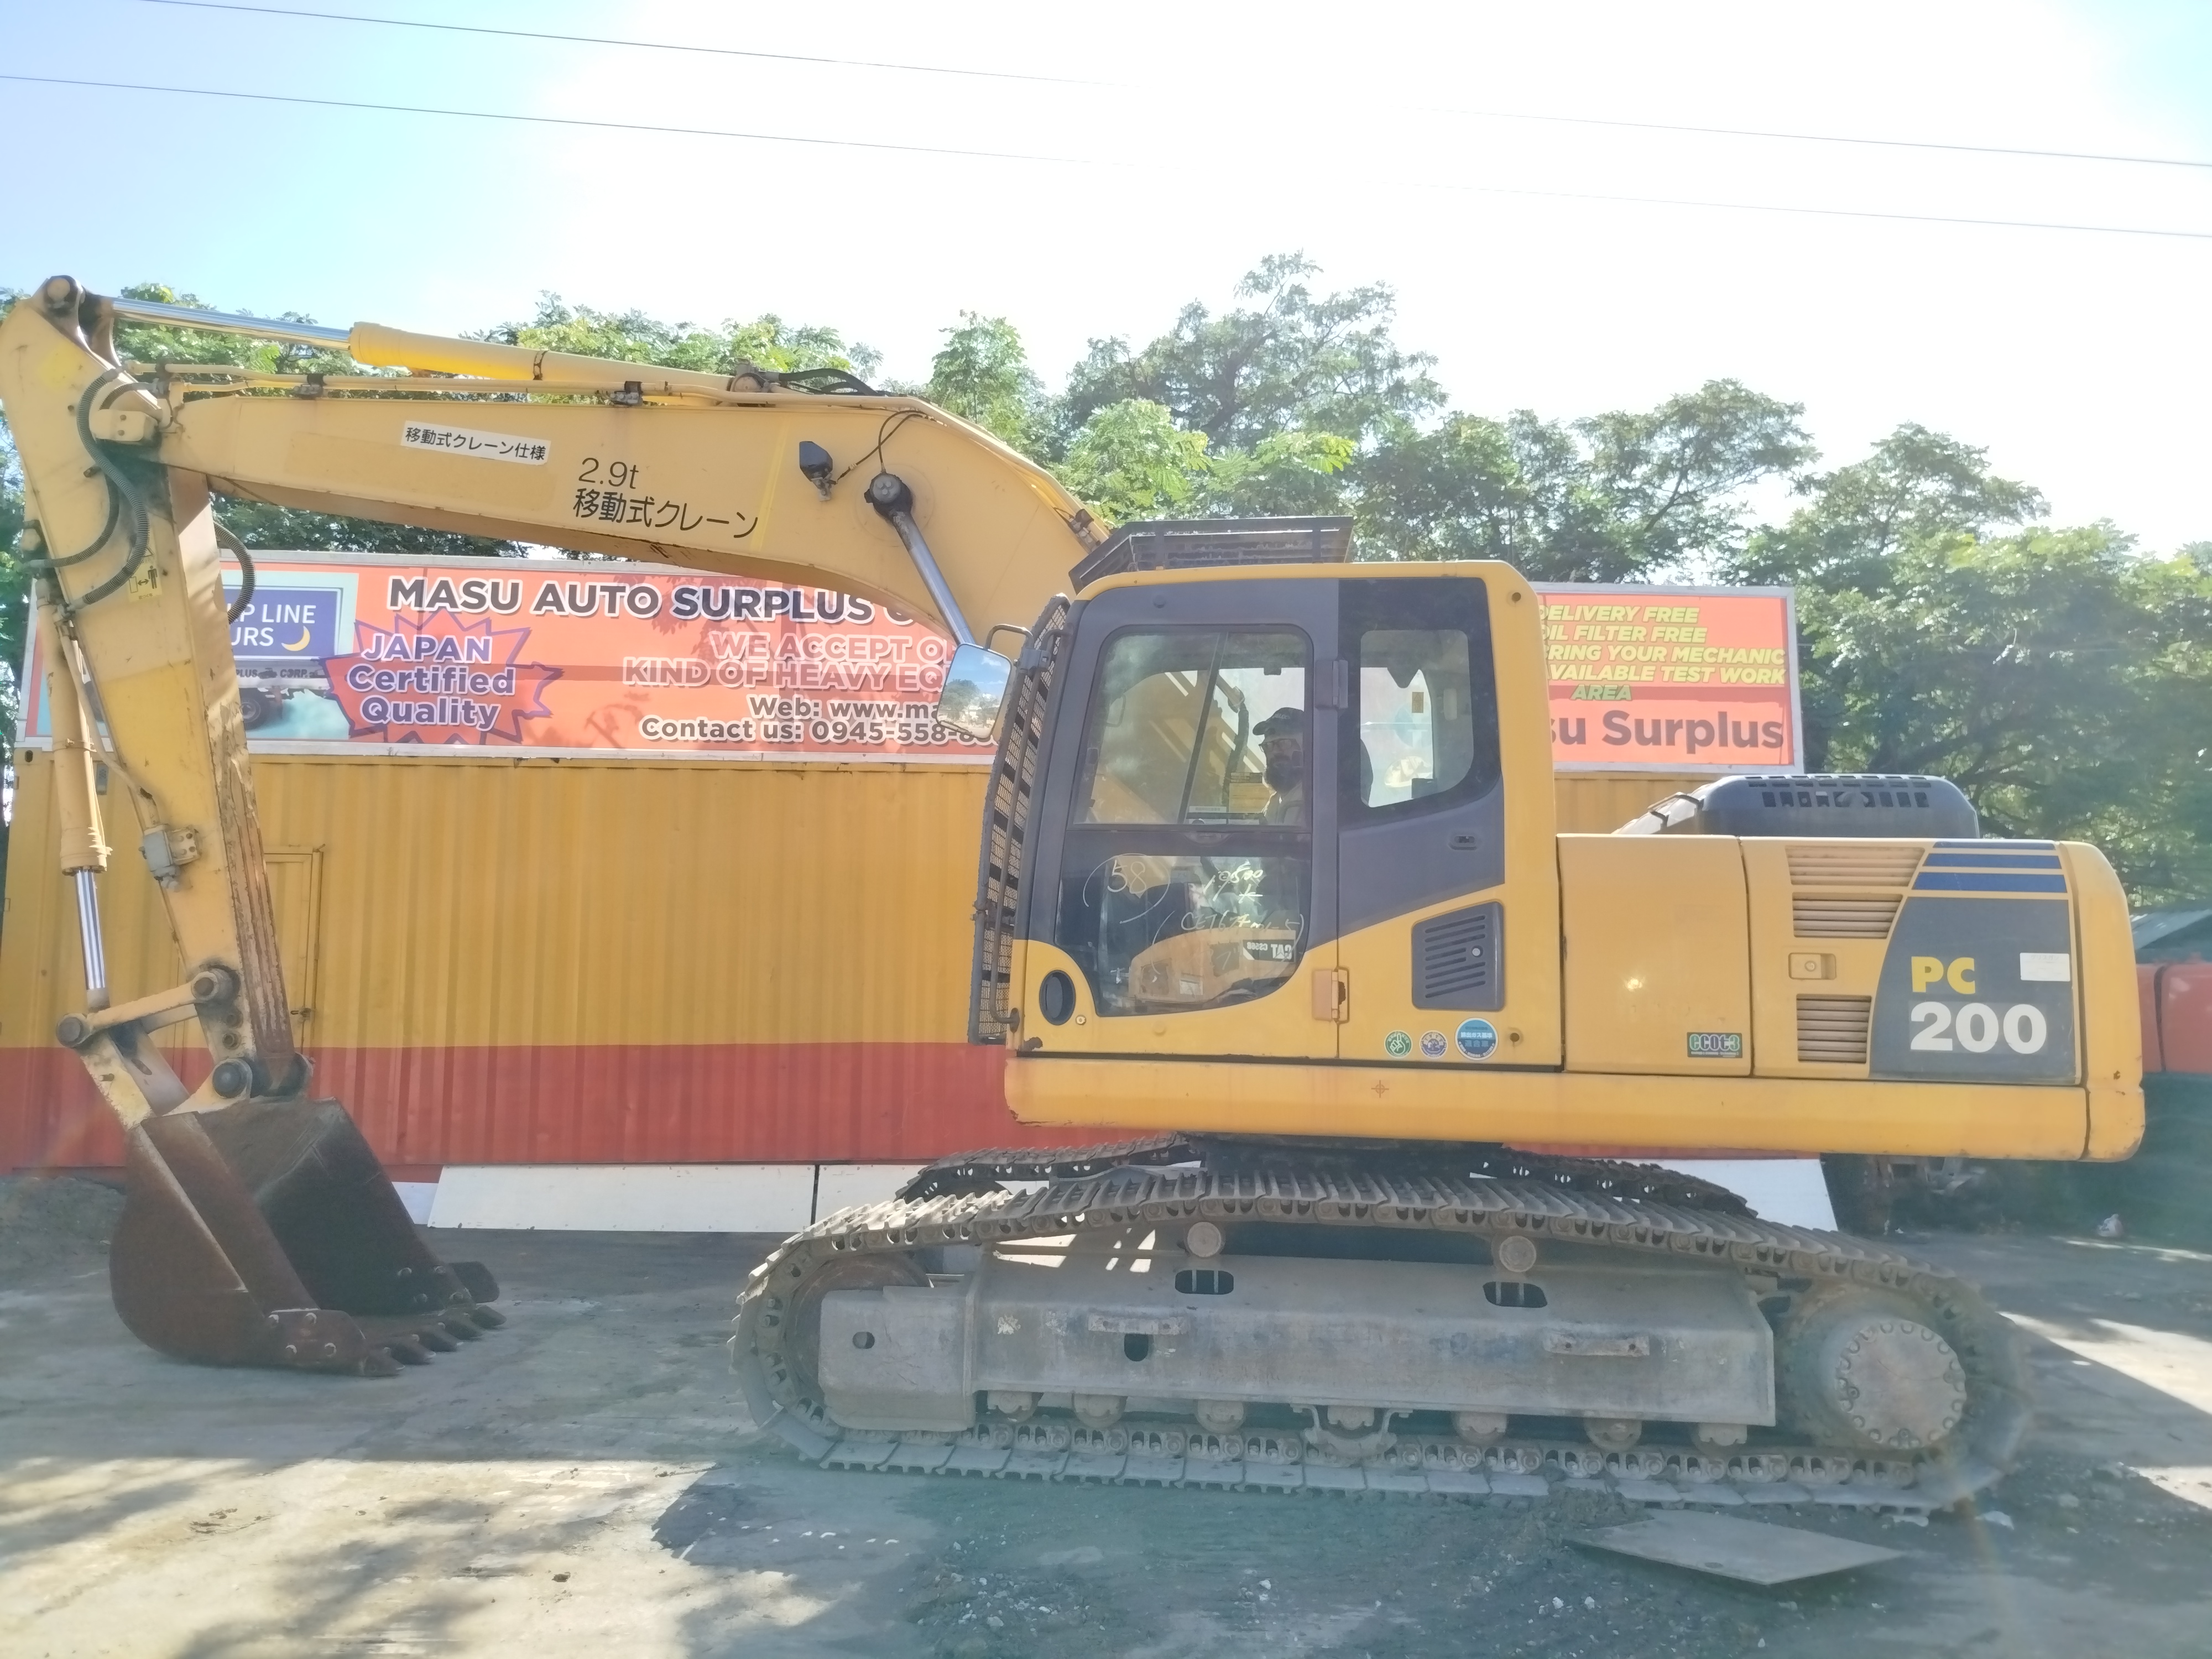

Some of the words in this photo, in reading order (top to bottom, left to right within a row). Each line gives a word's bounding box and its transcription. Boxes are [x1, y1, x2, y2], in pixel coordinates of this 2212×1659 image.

[405, 426, 546, 461] 移動式クレーン仕様
[578, 457, 639, 490] 2.9t
[573, 488, 759, 539] 移動式クレーン
[262, 604, 316, 624] LINE
[388, 577, 521, 611] MASU
[538, 583, 660, 617] AUTO
[672, 586, 873, 622] SURPLUS
[1642, 607, 1700, 624] FREE
[363, 634, 492, 662] JAPAN
[712, 632, 769, 660] WE
[779, 635, 911, 663] ACCEPT
[1573, 625, 1647, 642] FILTER
[1650, 627, 1708, 643] FREE
[1547, 645, 1602, 661] RING
[1608, 645, 1667, 662] YOUR
[1671, 647, 1786, 665] MECHANIC
[280, 669, 308, 677] CORP.
[347, 665, 515, 695] Certified
[624, 659, 711, 686] KIND
[718, 660, 767, 687] OF
[778, 662, 890, 690] HEAVY
[897, 665, 950, 691] EQ
[1548, 664, 1656, 682] VAILABLE
[1661, 667, 1715, 683] TEST
[1720, 667, 1787, 685] WORK
[1571, 684, 1632, 701] AREA
[361, 697, 500, 731] Quality
[750, 697, 821, 719] Web:
[643, 718, 757, 740] Contact
[763, 721, 804, 742] us:
[1602, 709, 1784, 754] Surplus
[1911, 956, 1976, 994] PC
[1911, 1001, 2047, 1055] 200
